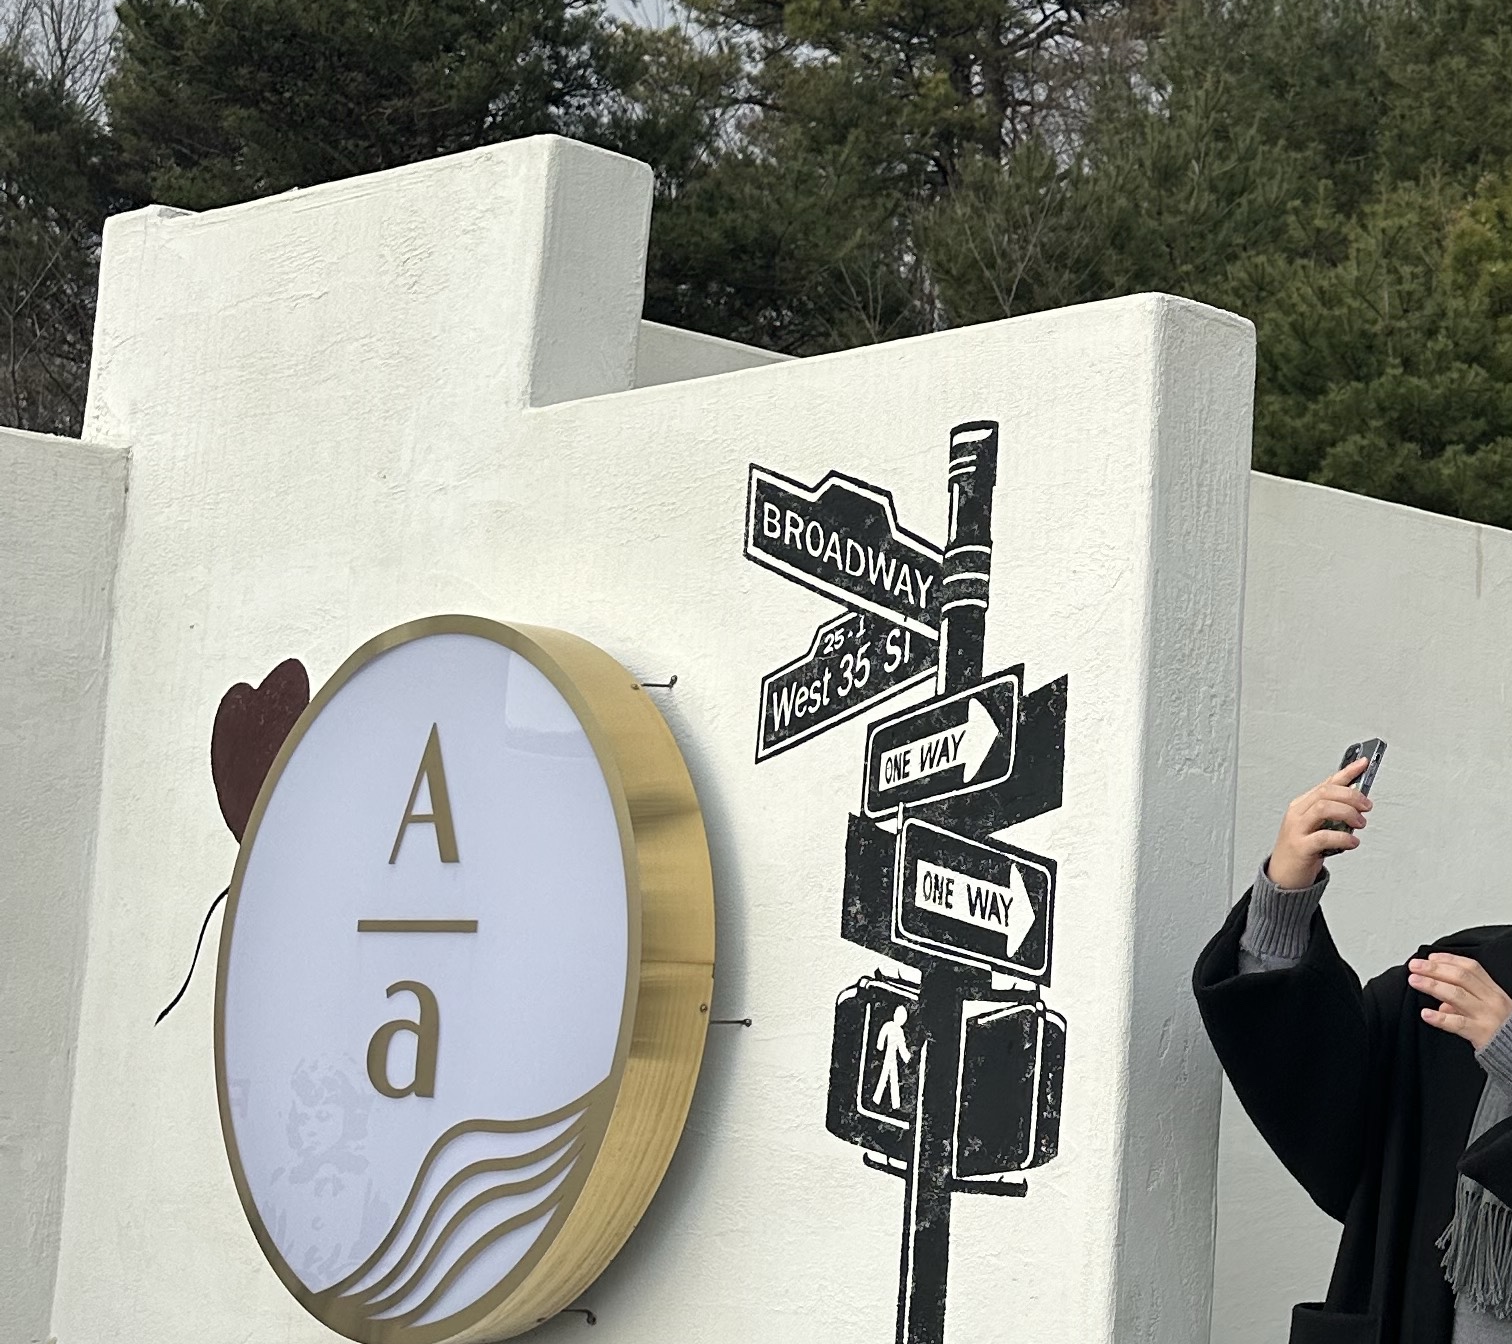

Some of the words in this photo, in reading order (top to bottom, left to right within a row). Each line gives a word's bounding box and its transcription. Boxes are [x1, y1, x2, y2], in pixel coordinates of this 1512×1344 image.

[762, 501, 934, 609] BROADWAY
[771, 666, 832, 732] West
[837, 641, 872, 696] 35
[388, 722, 461, 865] A
[884, 749, 911, 785] ONE
[919, 729, 967, 773] WAY
[922, 870, 955, 910] ONE
[966, 883, 1014, 928] WAY
[365, 979, 441, 1100] a
